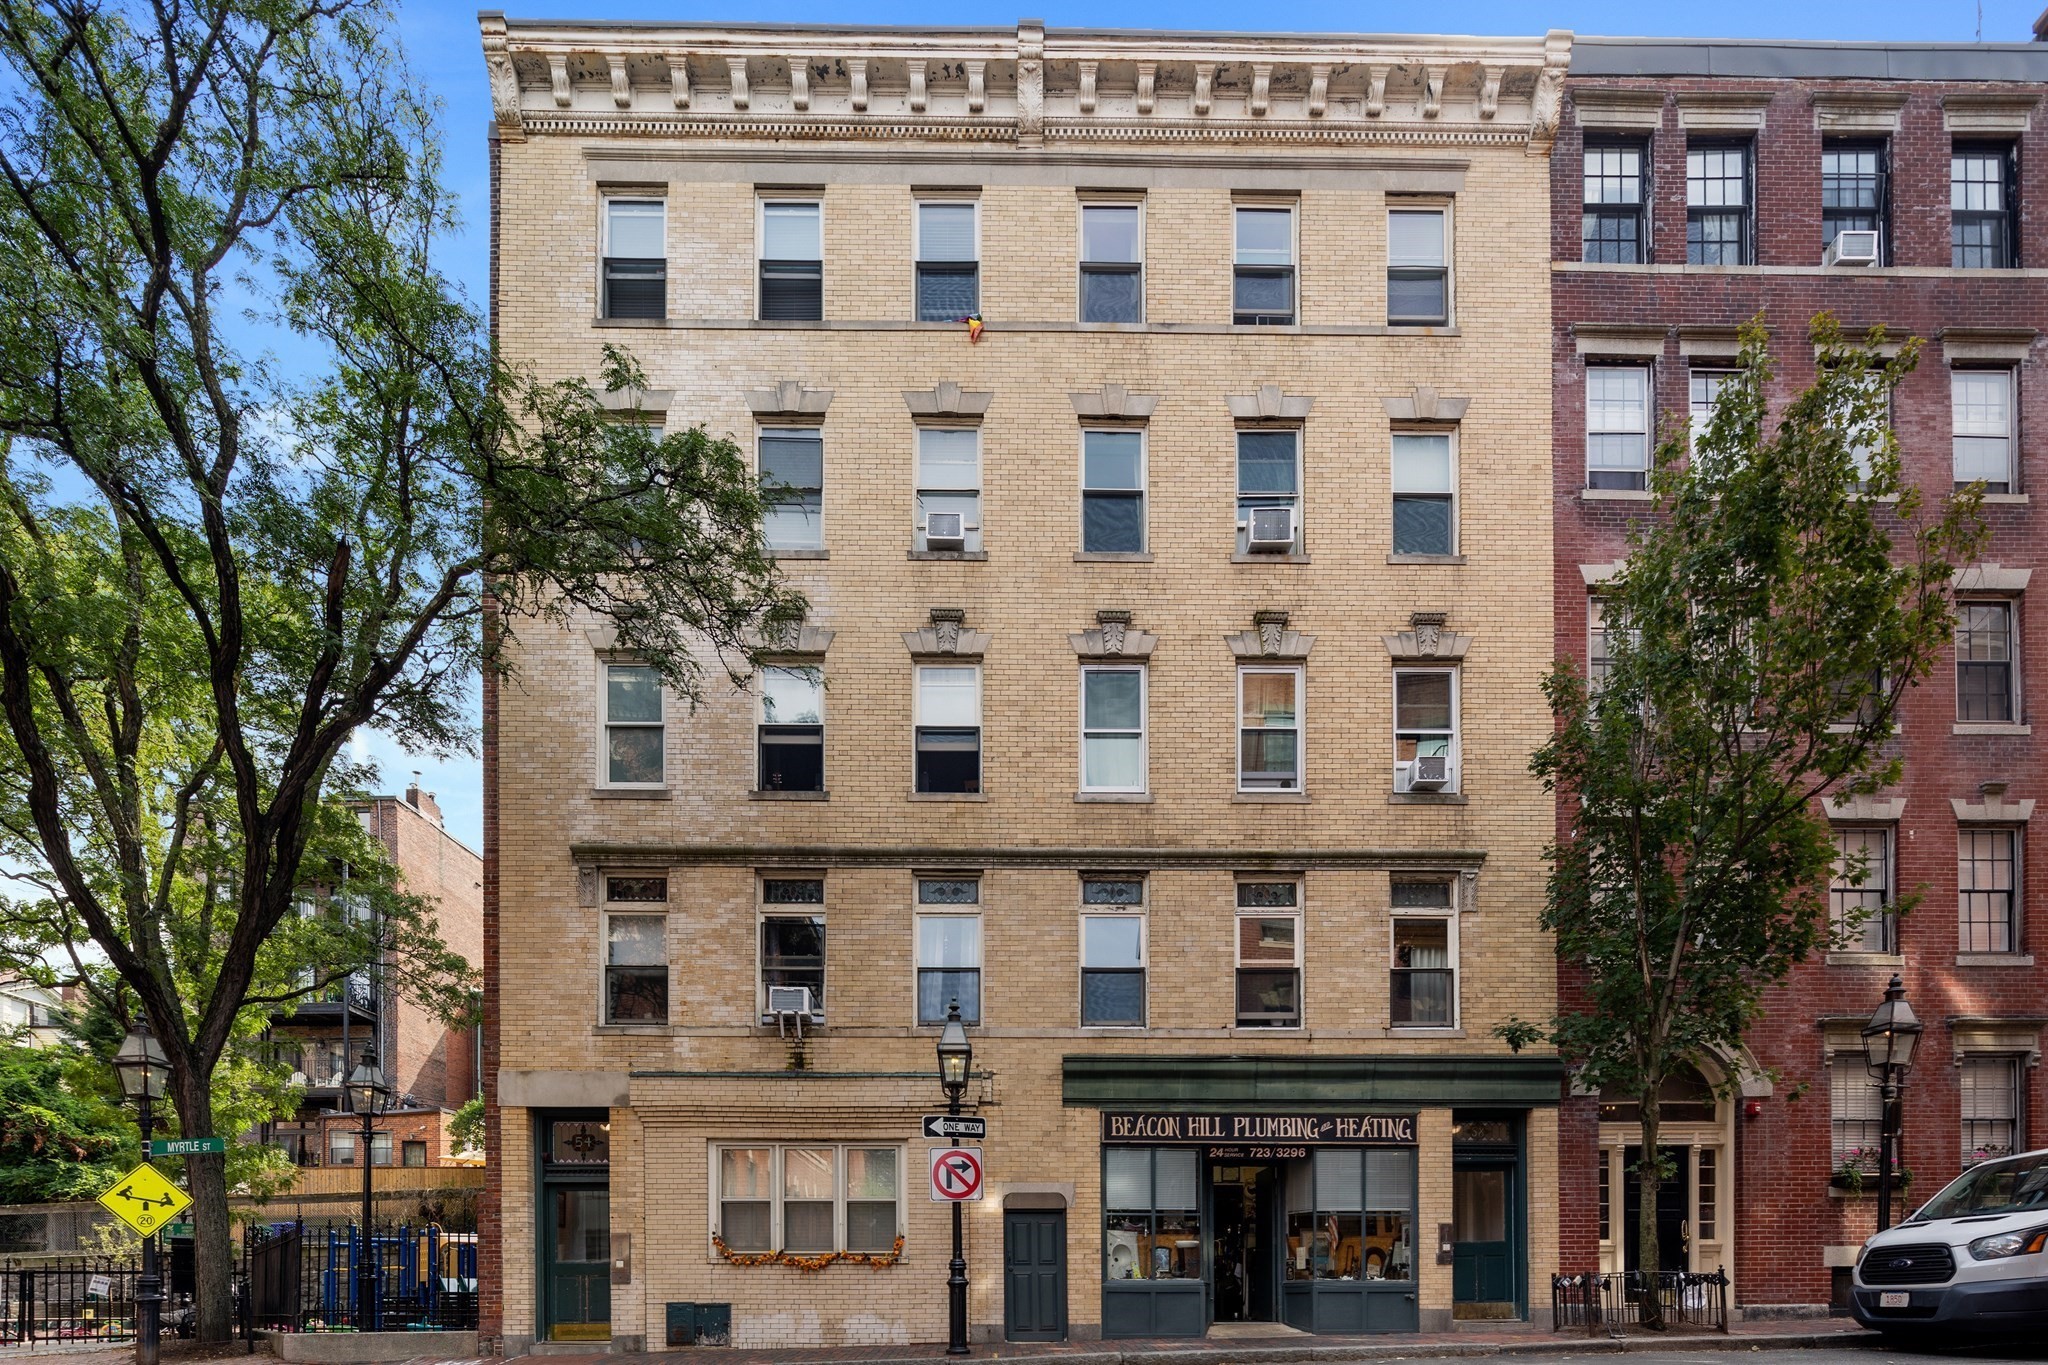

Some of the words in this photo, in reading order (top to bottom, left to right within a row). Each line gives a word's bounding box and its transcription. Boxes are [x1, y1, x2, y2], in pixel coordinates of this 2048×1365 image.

[942, 1122, 960, 1132] ONE
[963, 1123, 981, 1132] WAY
[1111, 1114, 1181, 1139] BEACON
[1187, 1116, 1226, 1137] HILL
[1233, 1117, 1319, 1140] PLUMBING
[1335, 1115, 1413, 1141] HEATING
[167, 1140, 200, 1153] MYRTLE
[202, 1142, 211, 1151] ST
[575, 1136, 592, 1148] 54
[1209, 1147, 1224, 1158] 24
[1249, 1147, 1306, 1158] 723/3296
[139, 1216, 153, 1226] 20
